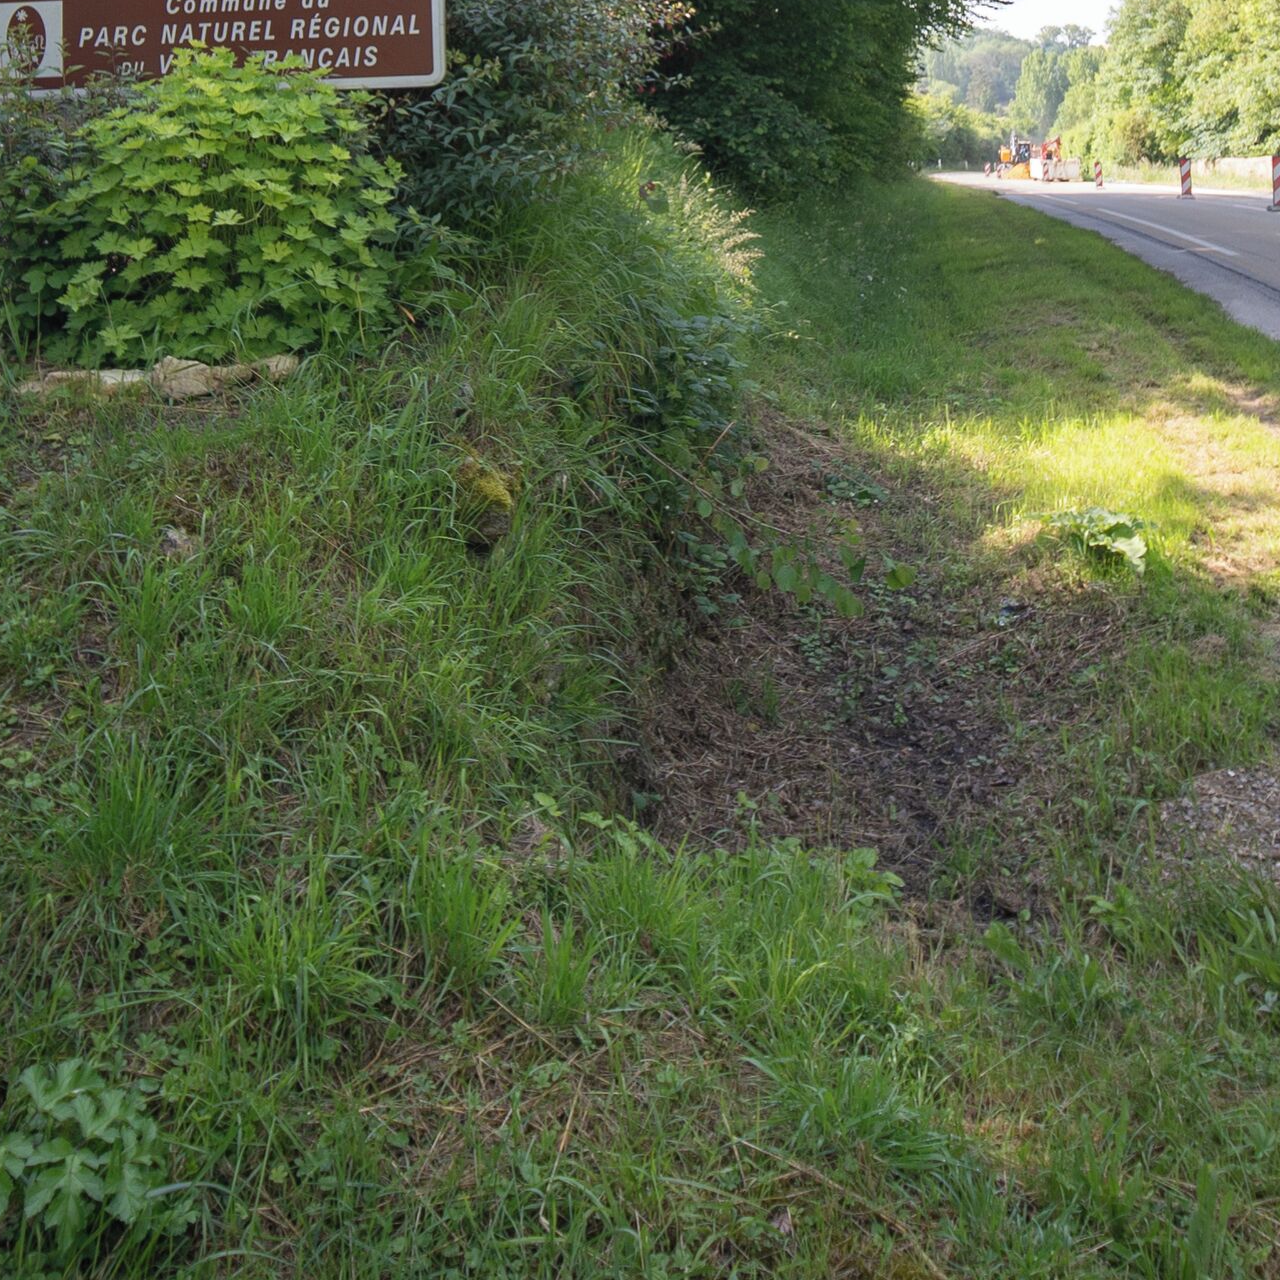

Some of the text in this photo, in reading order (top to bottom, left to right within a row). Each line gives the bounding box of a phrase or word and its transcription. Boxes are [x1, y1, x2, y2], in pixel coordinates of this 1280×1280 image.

[79, 13, 421, 48] PARC NATUREL RÉGIONAL
